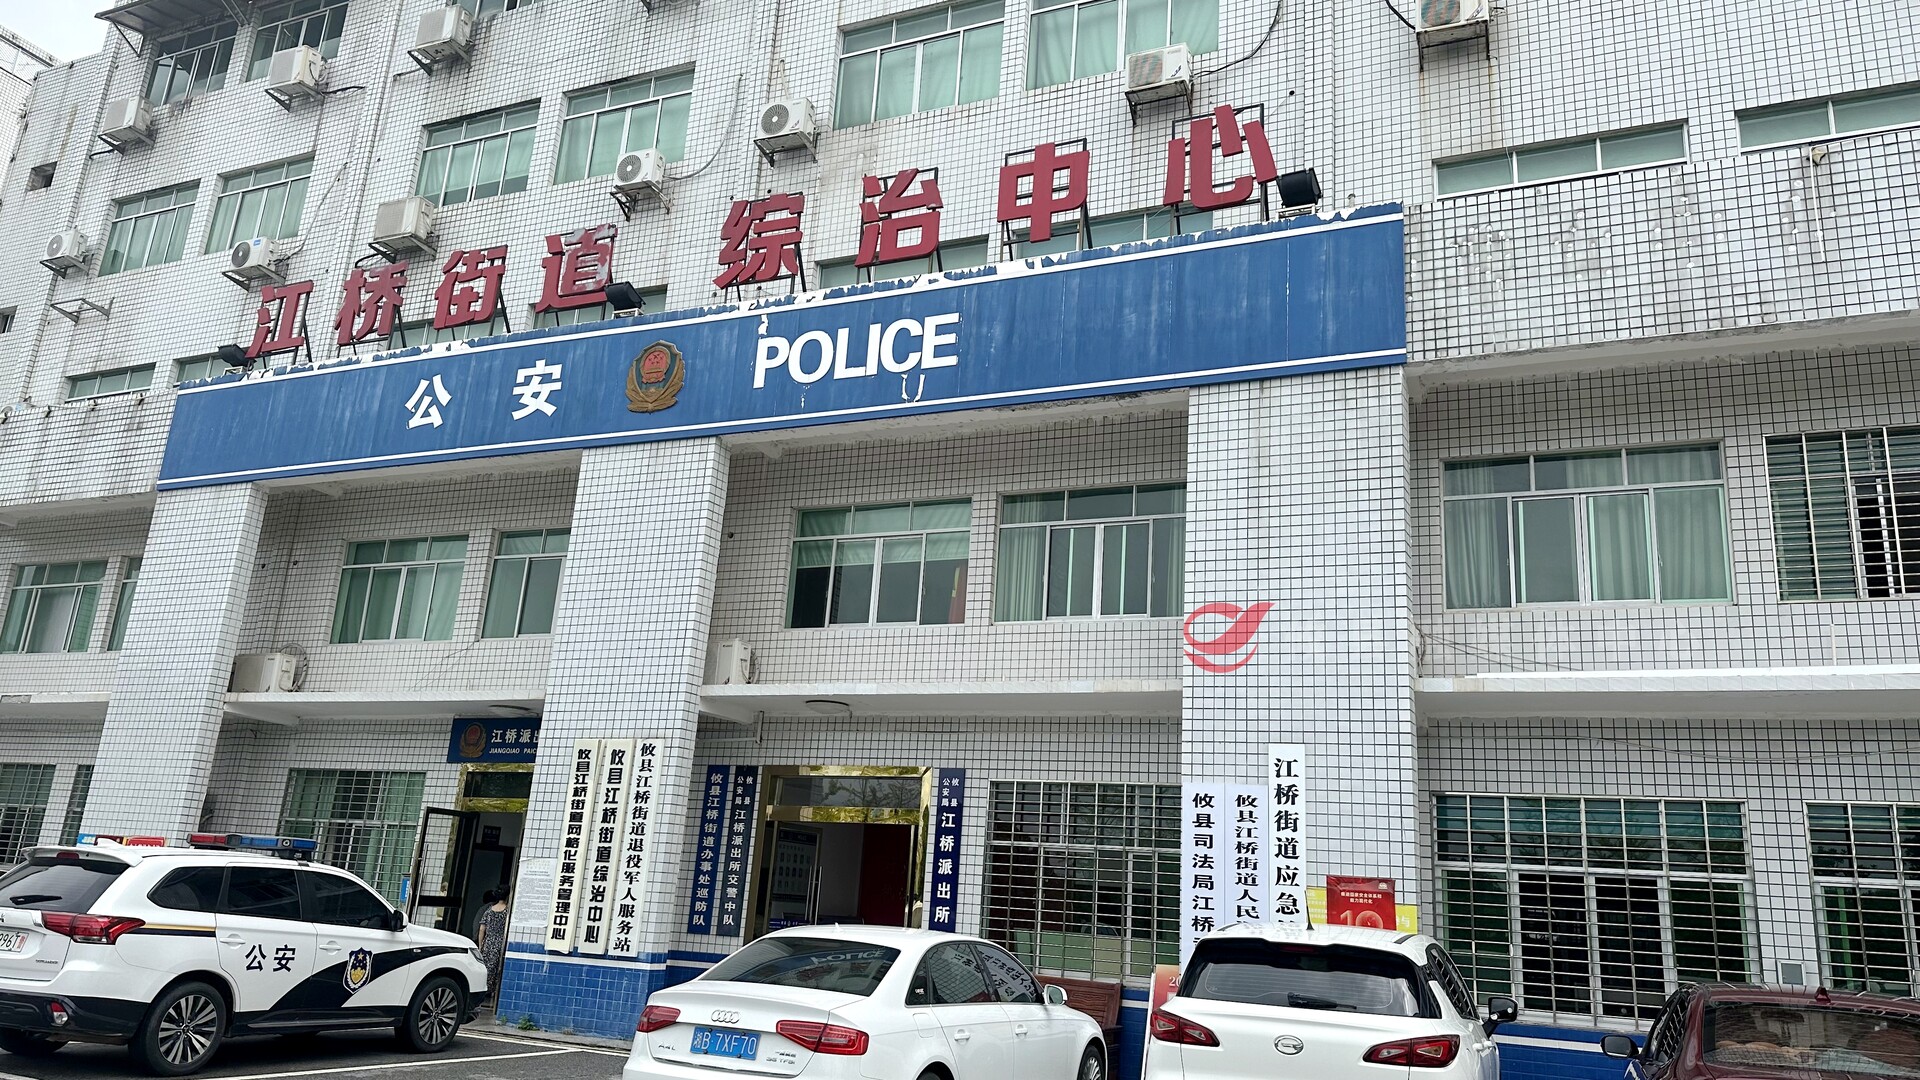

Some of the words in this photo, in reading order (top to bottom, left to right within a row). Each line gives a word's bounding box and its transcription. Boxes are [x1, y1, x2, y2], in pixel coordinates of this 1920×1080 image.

[246, 223, 618, 358] 江桥街道
[713, 104, 1277, 289] 综治中心
[404, 358, 563, 430] 公安
[753, 312, 960, 389] POLICE
[551, 748, 592, 940] 攸县江桥街道网格化服务管理中心
[584, 749, 625, 944] 攸县江桥街道综治中心
[613, 742, 656, 952] 攸县江桥街道退役军人服务站
[693, 773, 723, 926] 攸县江桥街道办事处巡防队
[723, 809, 746, 926] 江桥派出所交警中队
[934, 812, 956, 924] 江桥派出所
[1191, 792, 1215, 946] 攸县司法局江桥
[1235, 794, 1260, 924] 攸县江桥街道人民
[1274, 757, 1300, 923] 江桥街道应急
[244, 944, 296, 973] 公安
